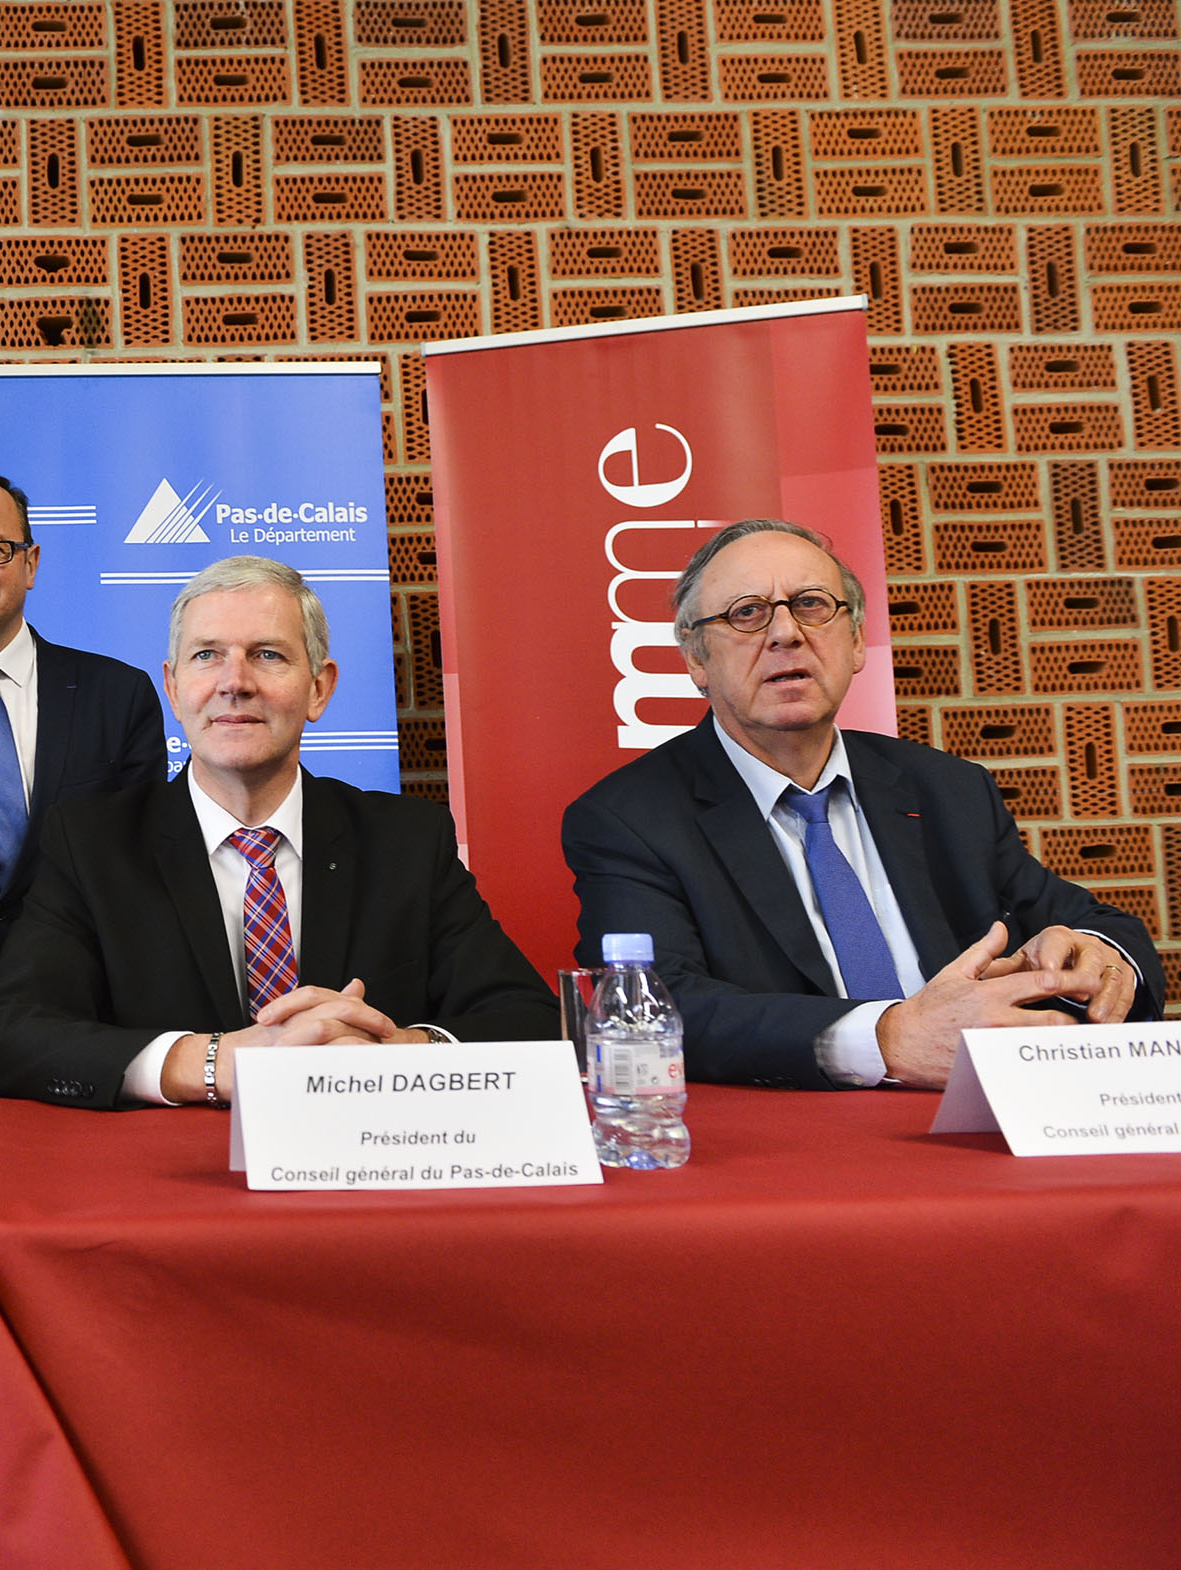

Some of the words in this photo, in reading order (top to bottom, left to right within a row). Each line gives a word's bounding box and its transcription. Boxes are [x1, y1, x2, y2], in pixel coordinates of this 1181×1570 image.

[230, 528, 249, 543] Le
[254, 527, 356, 546] Département
[1019, 1042, 1122, 1063] Christian
[1127, 1040, 1181, 1057] MAN
[306, 1075, 383, 1093] Michel
[392, 1072, 517, 1092] DAGBERT
[360, 1130, 448, 1146] Président
[454, 1129, 476, 1144] du
[1043, 1124, 1109, 1140] Conseil
[1114, 1122, 1180, 1140] général
[271, 1166, 340, 1183] Conseil
[346, 1165, 415, 1185] général
[421, 1165, 444, 1180] du
[450, 1161, 579, 1180] Pas-de-Calais
